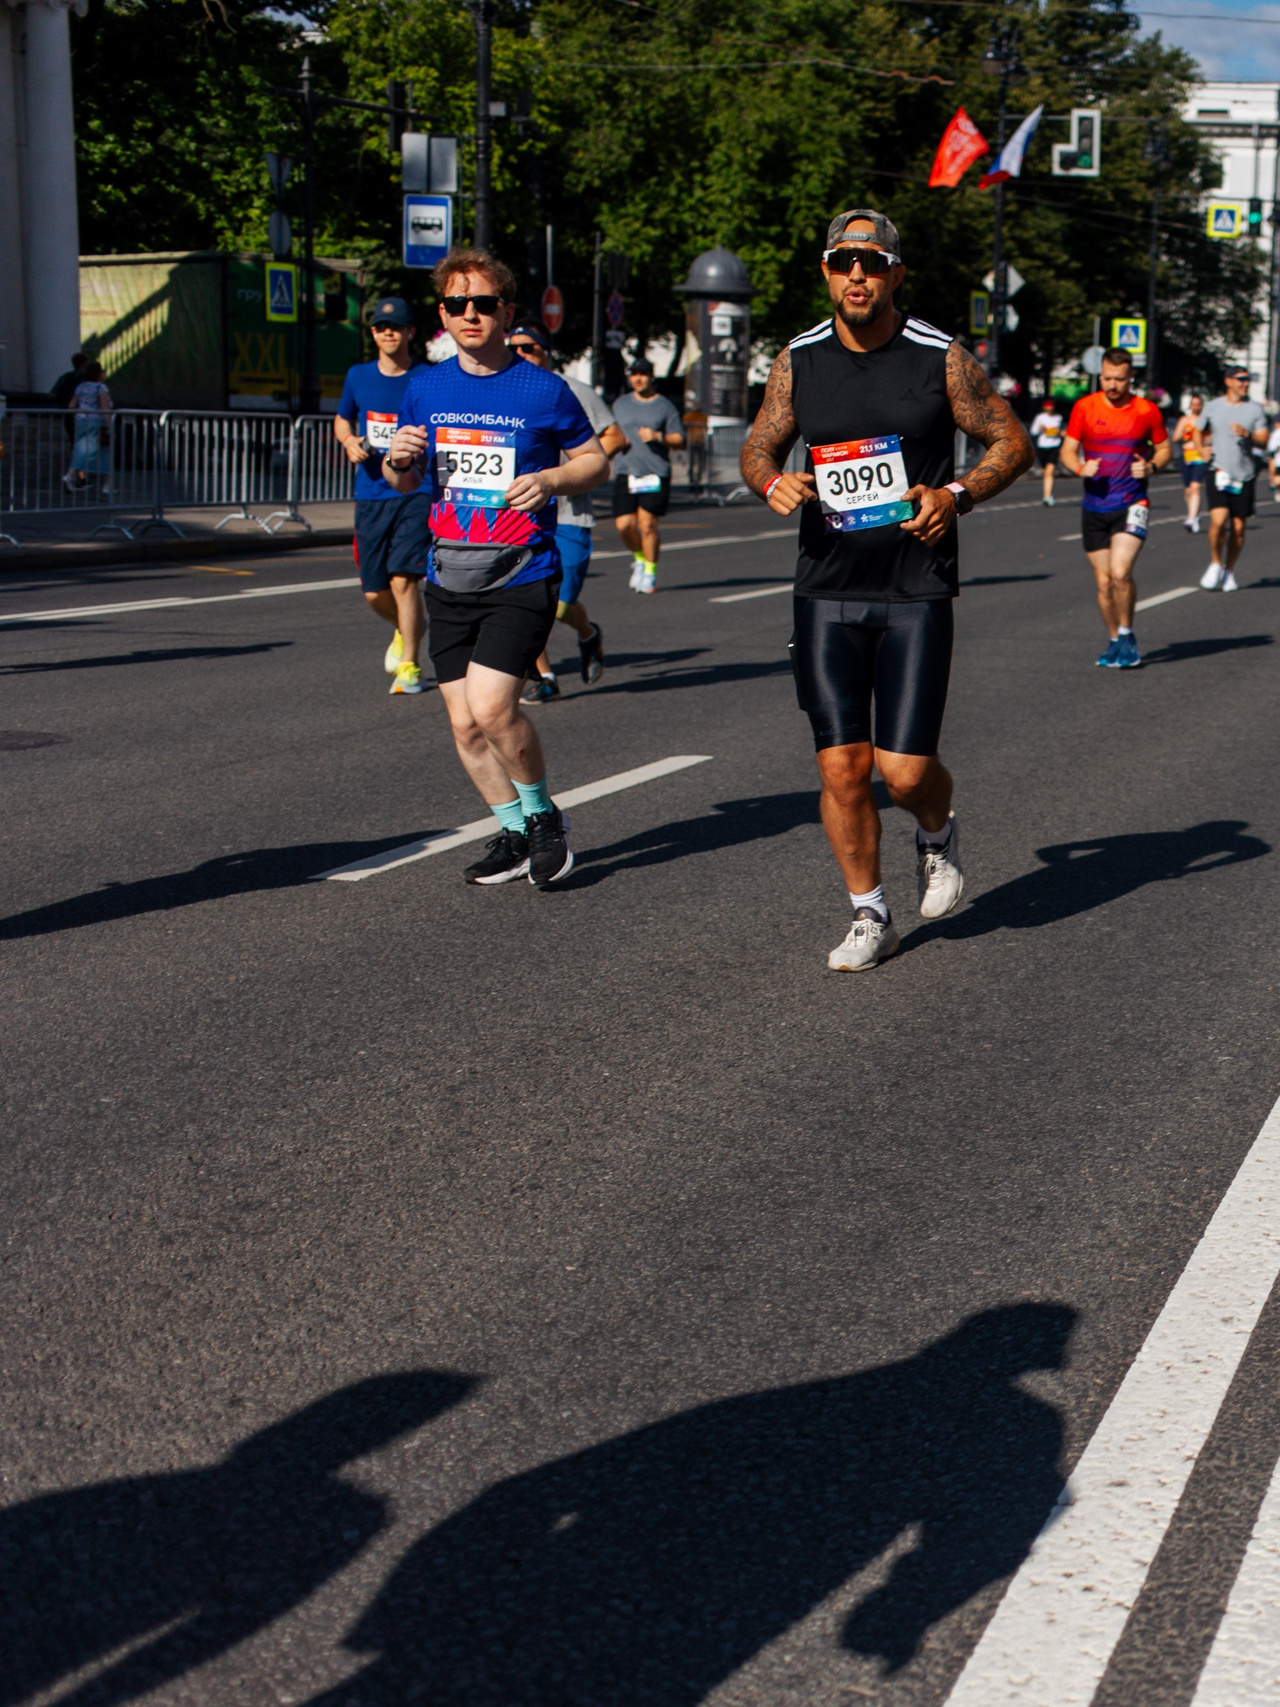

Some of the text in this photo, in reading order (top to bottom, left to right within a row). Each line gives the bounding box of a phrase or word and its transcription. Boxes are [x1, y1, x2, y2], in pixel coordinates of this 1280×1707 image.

[430, 412, 526, 429] СОВКОМБАНК
[446, 450, 503, 476] 5523
[826, 462, 894, 496] 3090
[846, 491, 879, 505] СЕРГЕЙ
